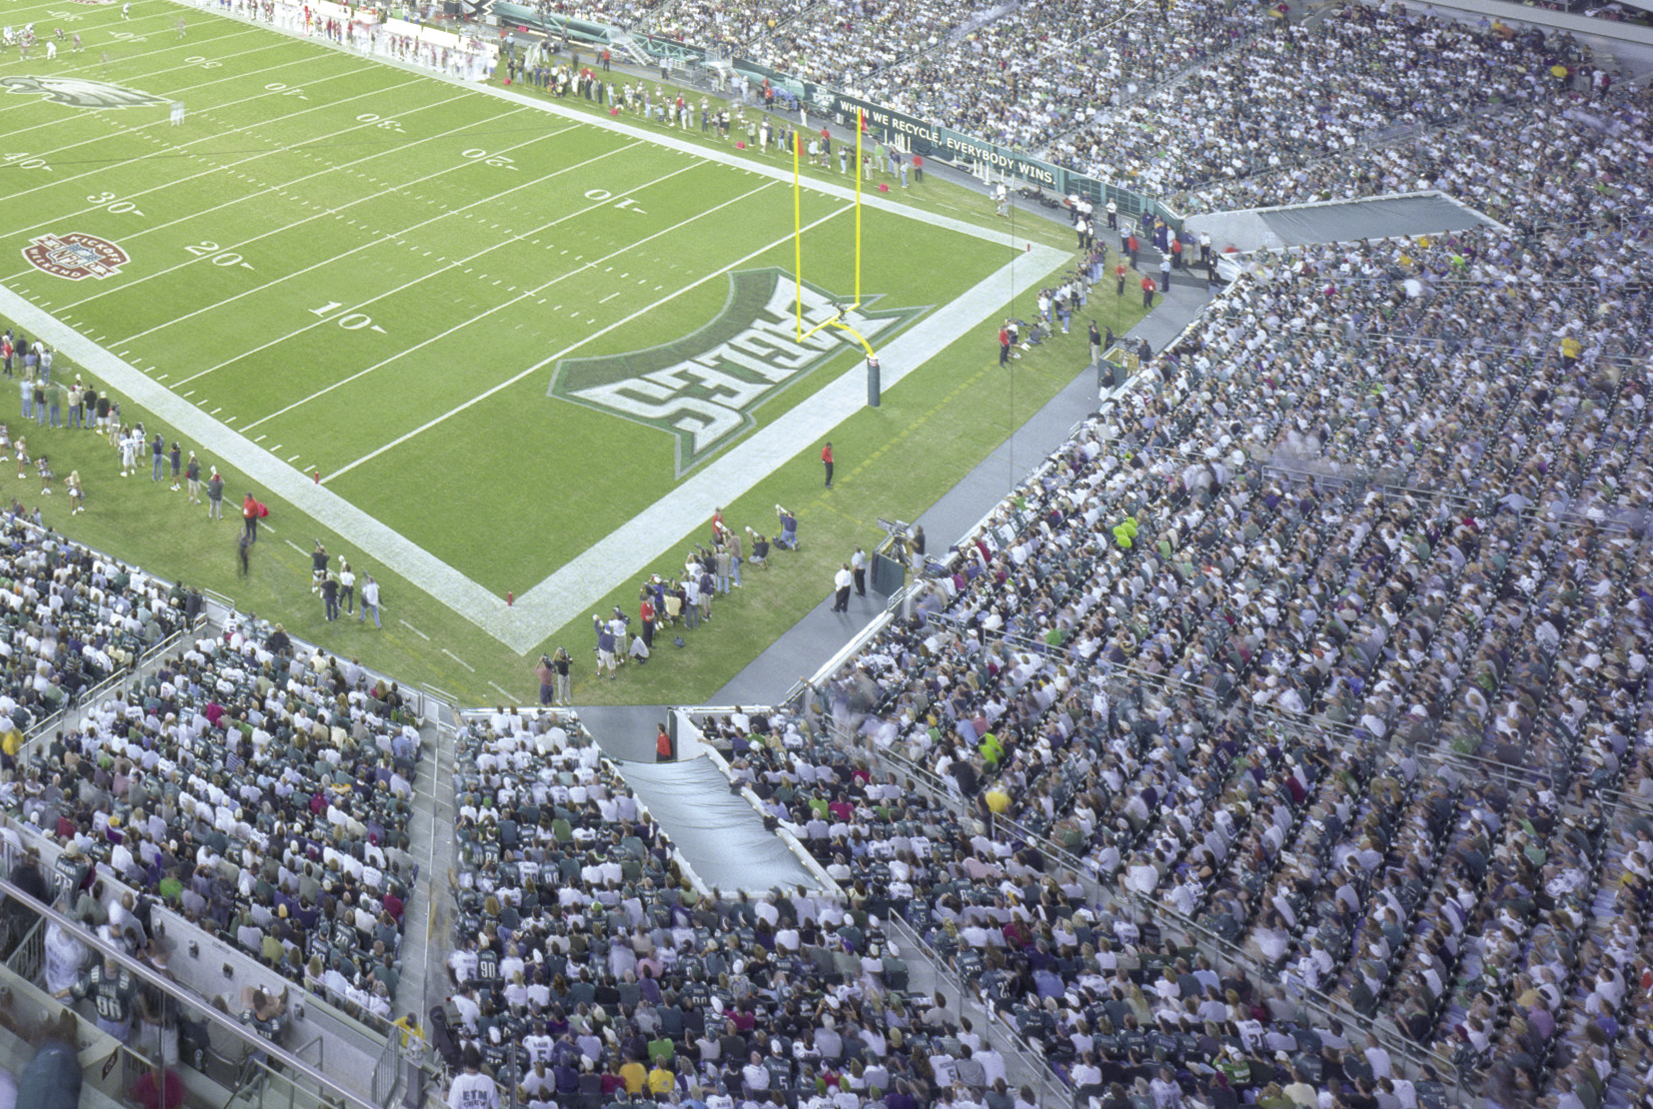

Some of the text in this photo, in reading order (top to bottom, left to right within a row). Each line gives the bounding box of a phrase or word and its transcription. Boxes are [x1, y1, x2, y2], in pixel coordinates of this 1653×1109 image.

[356, 113, 402, 129] 30
[461, 148, 515, 167] 20
[873, 110, 889, 127] WE
[891, 118, 943, 145] RECYCLE,
[947, 138, 1015, 170] EVERYBODY
[1018, 161, 1057, 185] WINS.
[3, 152, 46, 169] 40
[87, 192, 136, 214] 30
[584, 189, 641, 210] 10
[51, 249, 88, 266] NFL
[69, 235, 122, 263] KICKOFF
[184, 240, 243, 267] 20
[29, 248, 82, 278] WEEKEND
[308, 301, 372, 330] 10
[569, 275, 905, 454] EAGLES
[480, 961, 496, 978] 90
[779, 1076, 788, 1090] 5
